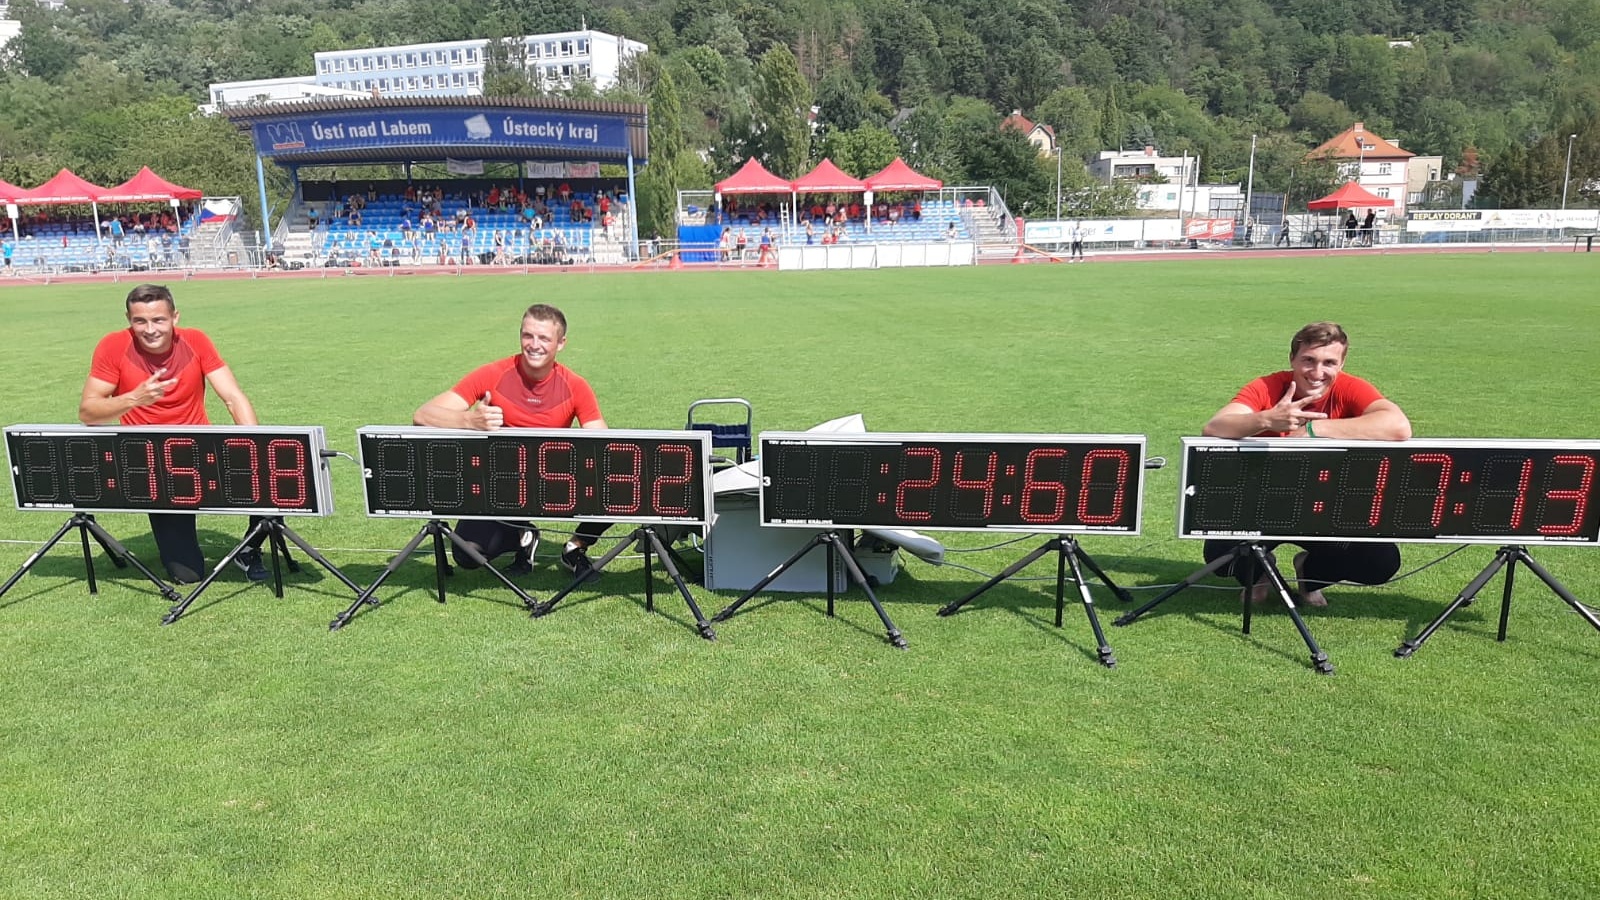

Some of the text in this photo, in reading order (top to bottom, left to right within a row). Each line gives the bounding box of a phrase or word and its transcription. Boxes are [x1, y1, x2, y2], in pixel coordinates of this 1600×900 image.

[311, 120, 432, 141] Ústí nad Labem
[503, 116, 598, 143] Ústecký kraj
[1444, 212, 1477, 220] DORANT
[12, 465, 19, 475] 1
[364, 468, 373, 478] 2
[762, 475, 771, 486] 3
[1184, 485, 1195, 496] 4
